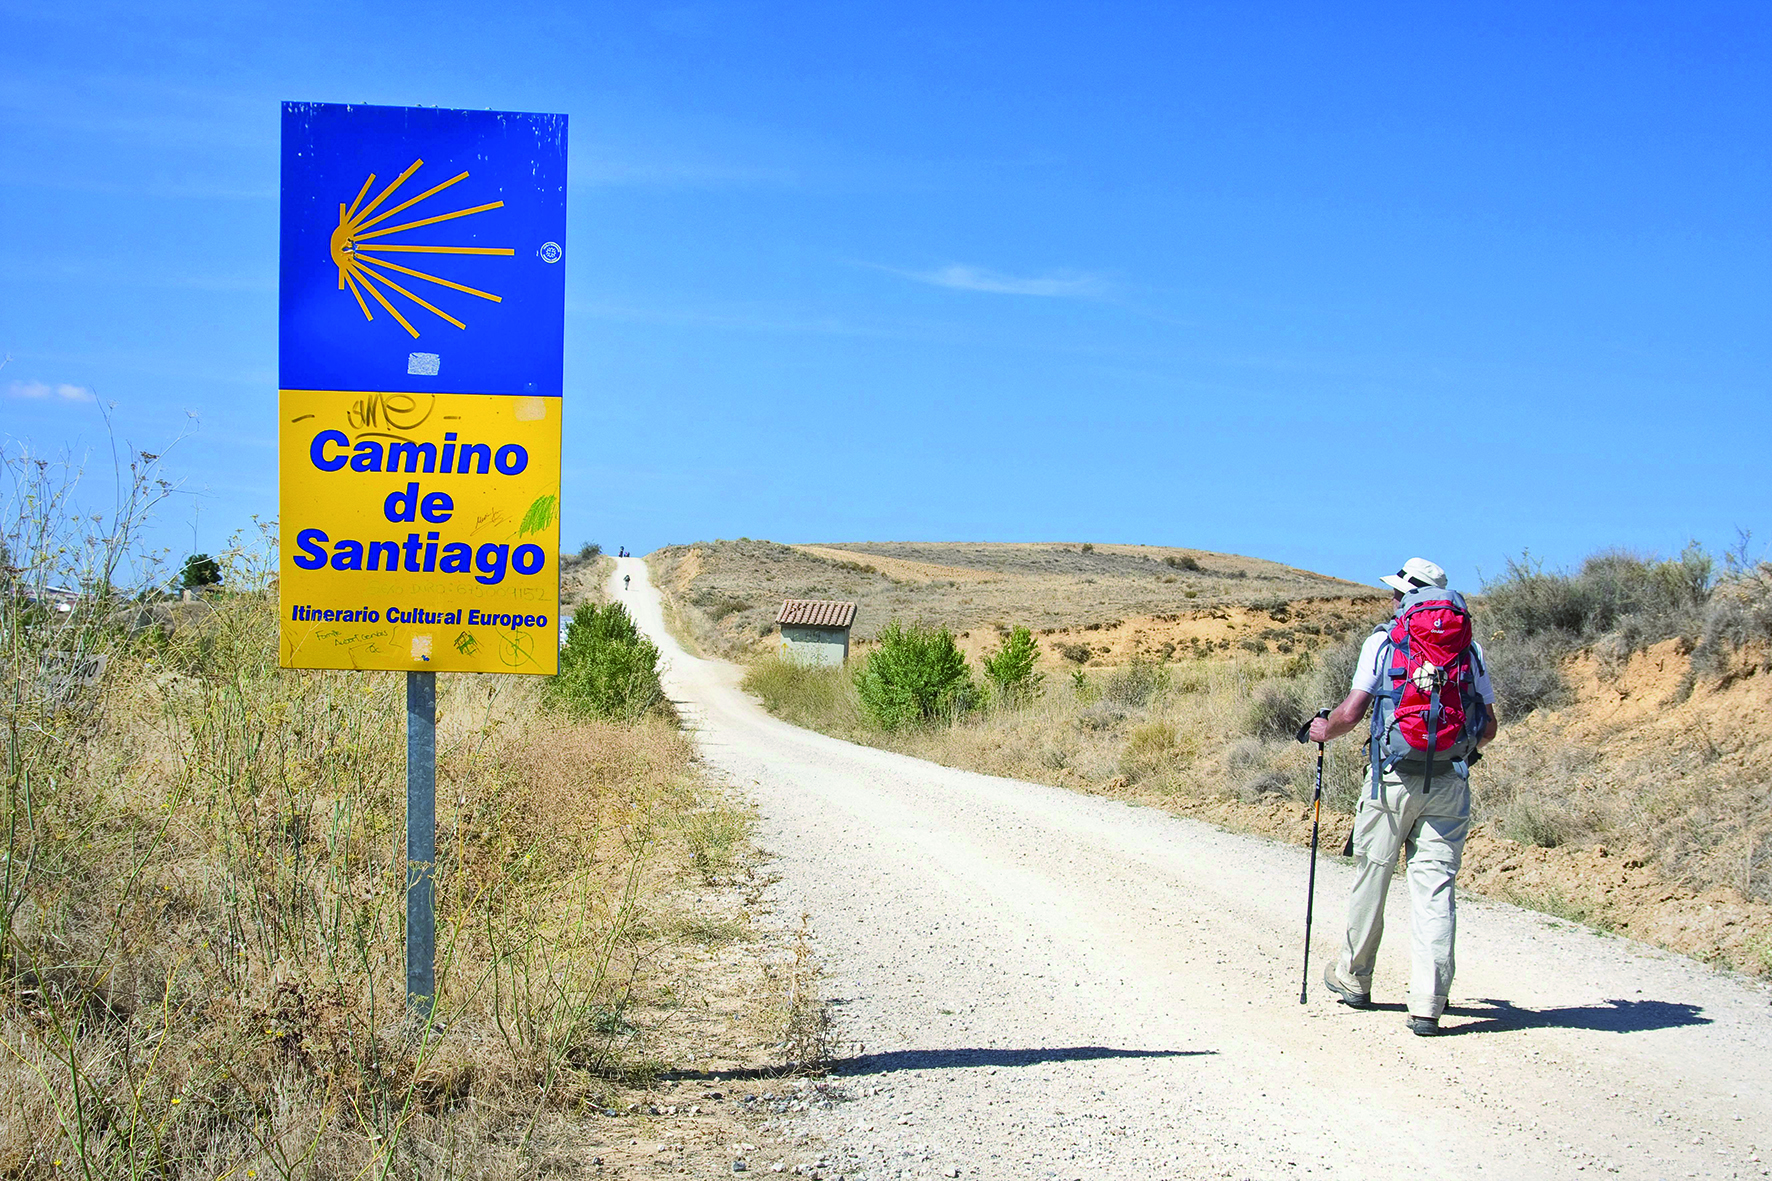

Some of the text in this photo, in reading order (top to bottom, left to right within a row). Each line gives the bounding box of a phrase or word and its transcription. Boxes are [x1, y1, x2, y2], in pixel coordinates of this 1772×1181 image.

[309, 429, 529, 476] Camino
[384, 482, 454, 524] de
[293, 528, 545, 586] Santiago
[292, 605, 548, 630] Itinerario Cultural Europeo
